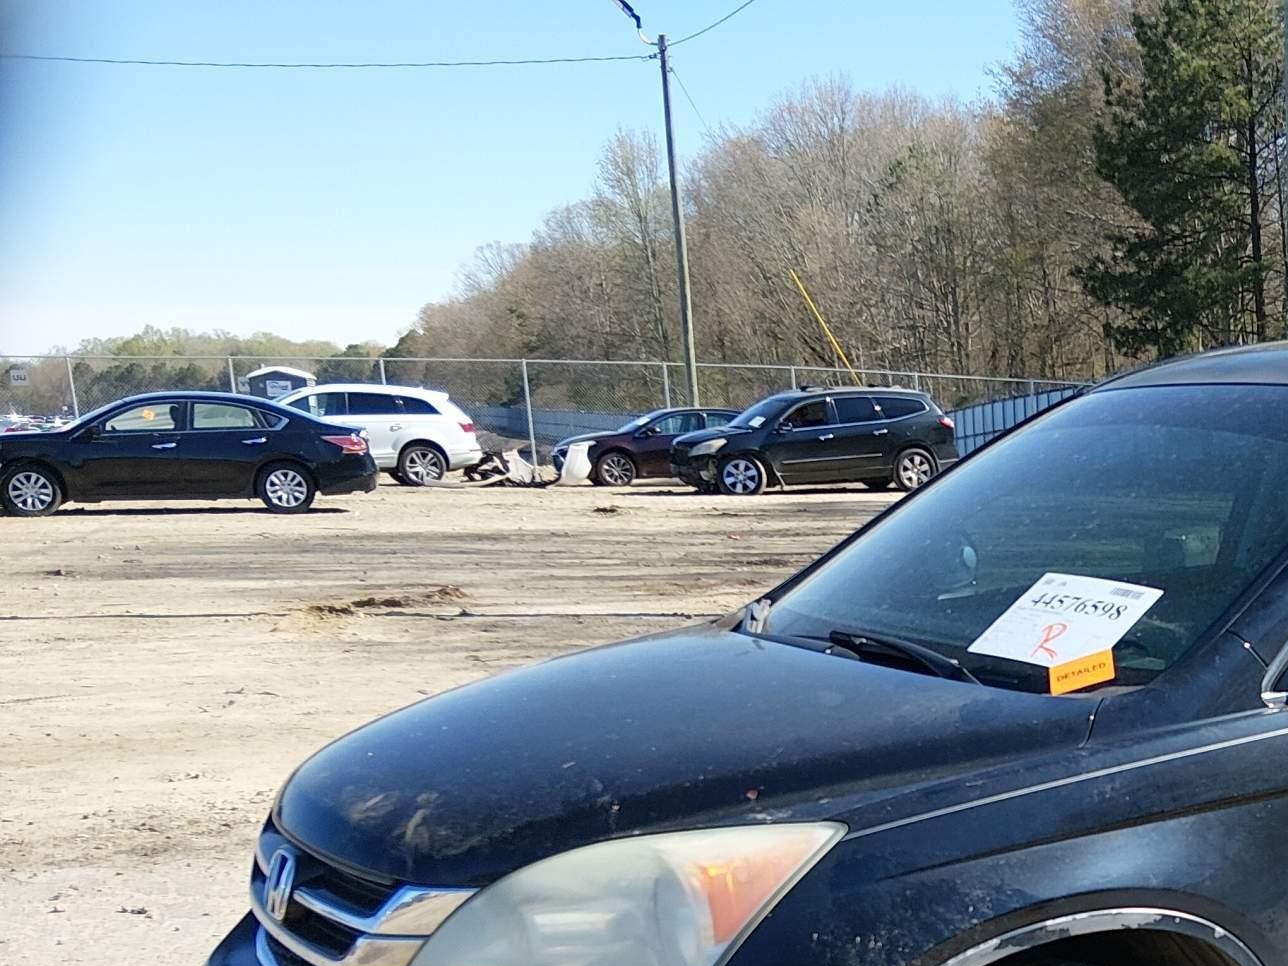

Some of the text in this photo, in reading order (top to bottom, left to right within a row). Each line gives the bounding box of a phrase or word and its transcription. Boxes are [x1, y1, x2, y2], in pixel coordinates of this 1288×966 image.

[1031, 592, 1129, 621] 44576598
[1030, 623, 1067, 660] R
[1056, 662, 1107, 682] DETAILED
